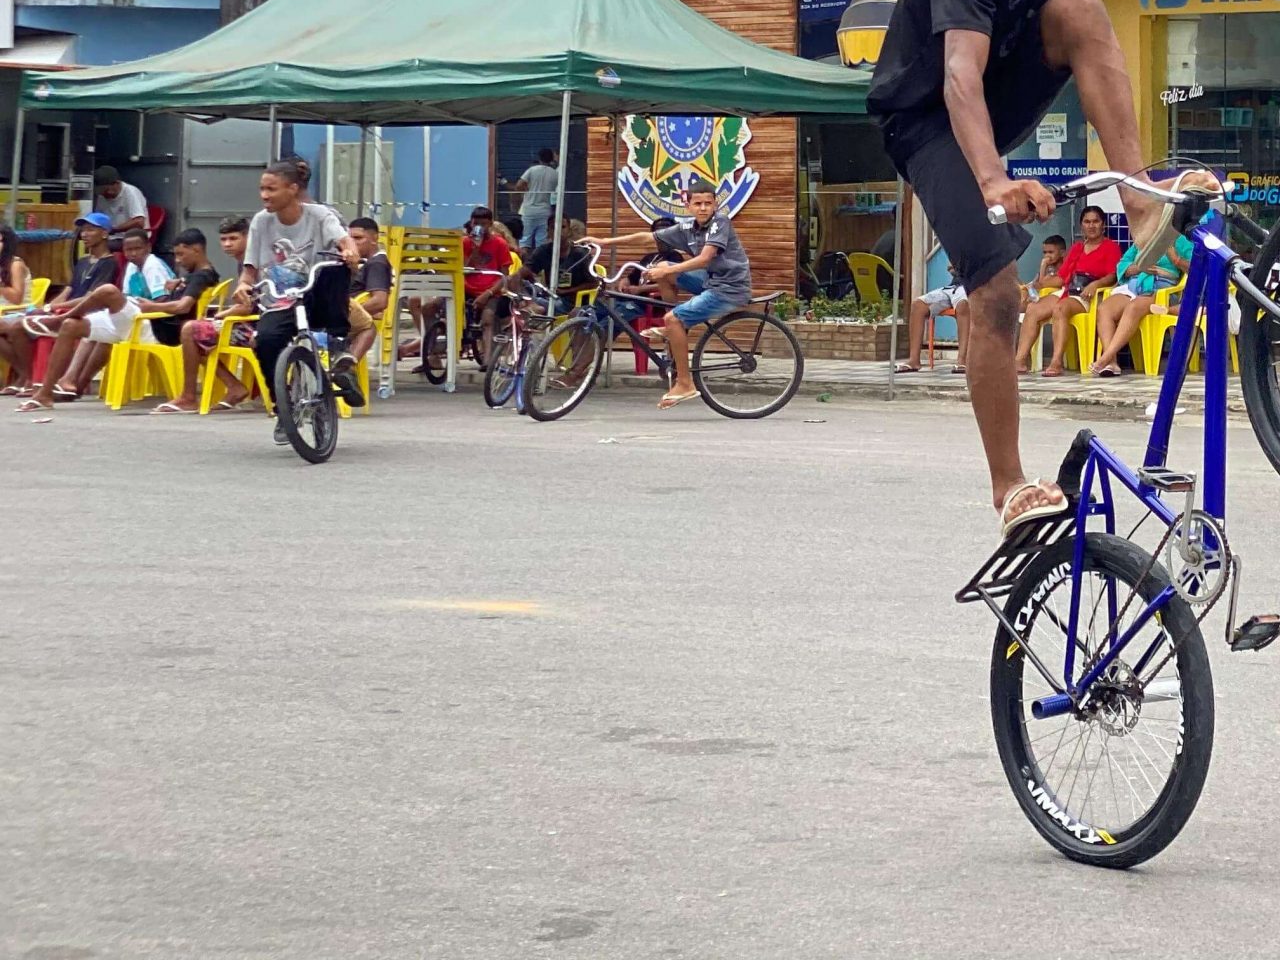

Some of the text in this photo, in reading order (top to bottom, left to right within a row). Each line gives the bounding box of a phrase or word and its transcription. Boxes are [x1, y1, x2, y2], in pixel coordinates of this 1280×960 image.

[1160, 82, 1204, 106] Feliz dia
[1013, 167, 1048, 176] POUSADA
[1049, 167, 1060, 176] DO
[1250, 189, 1266, 200] DO
[1027, 780, 1103, 844] VMAXX
